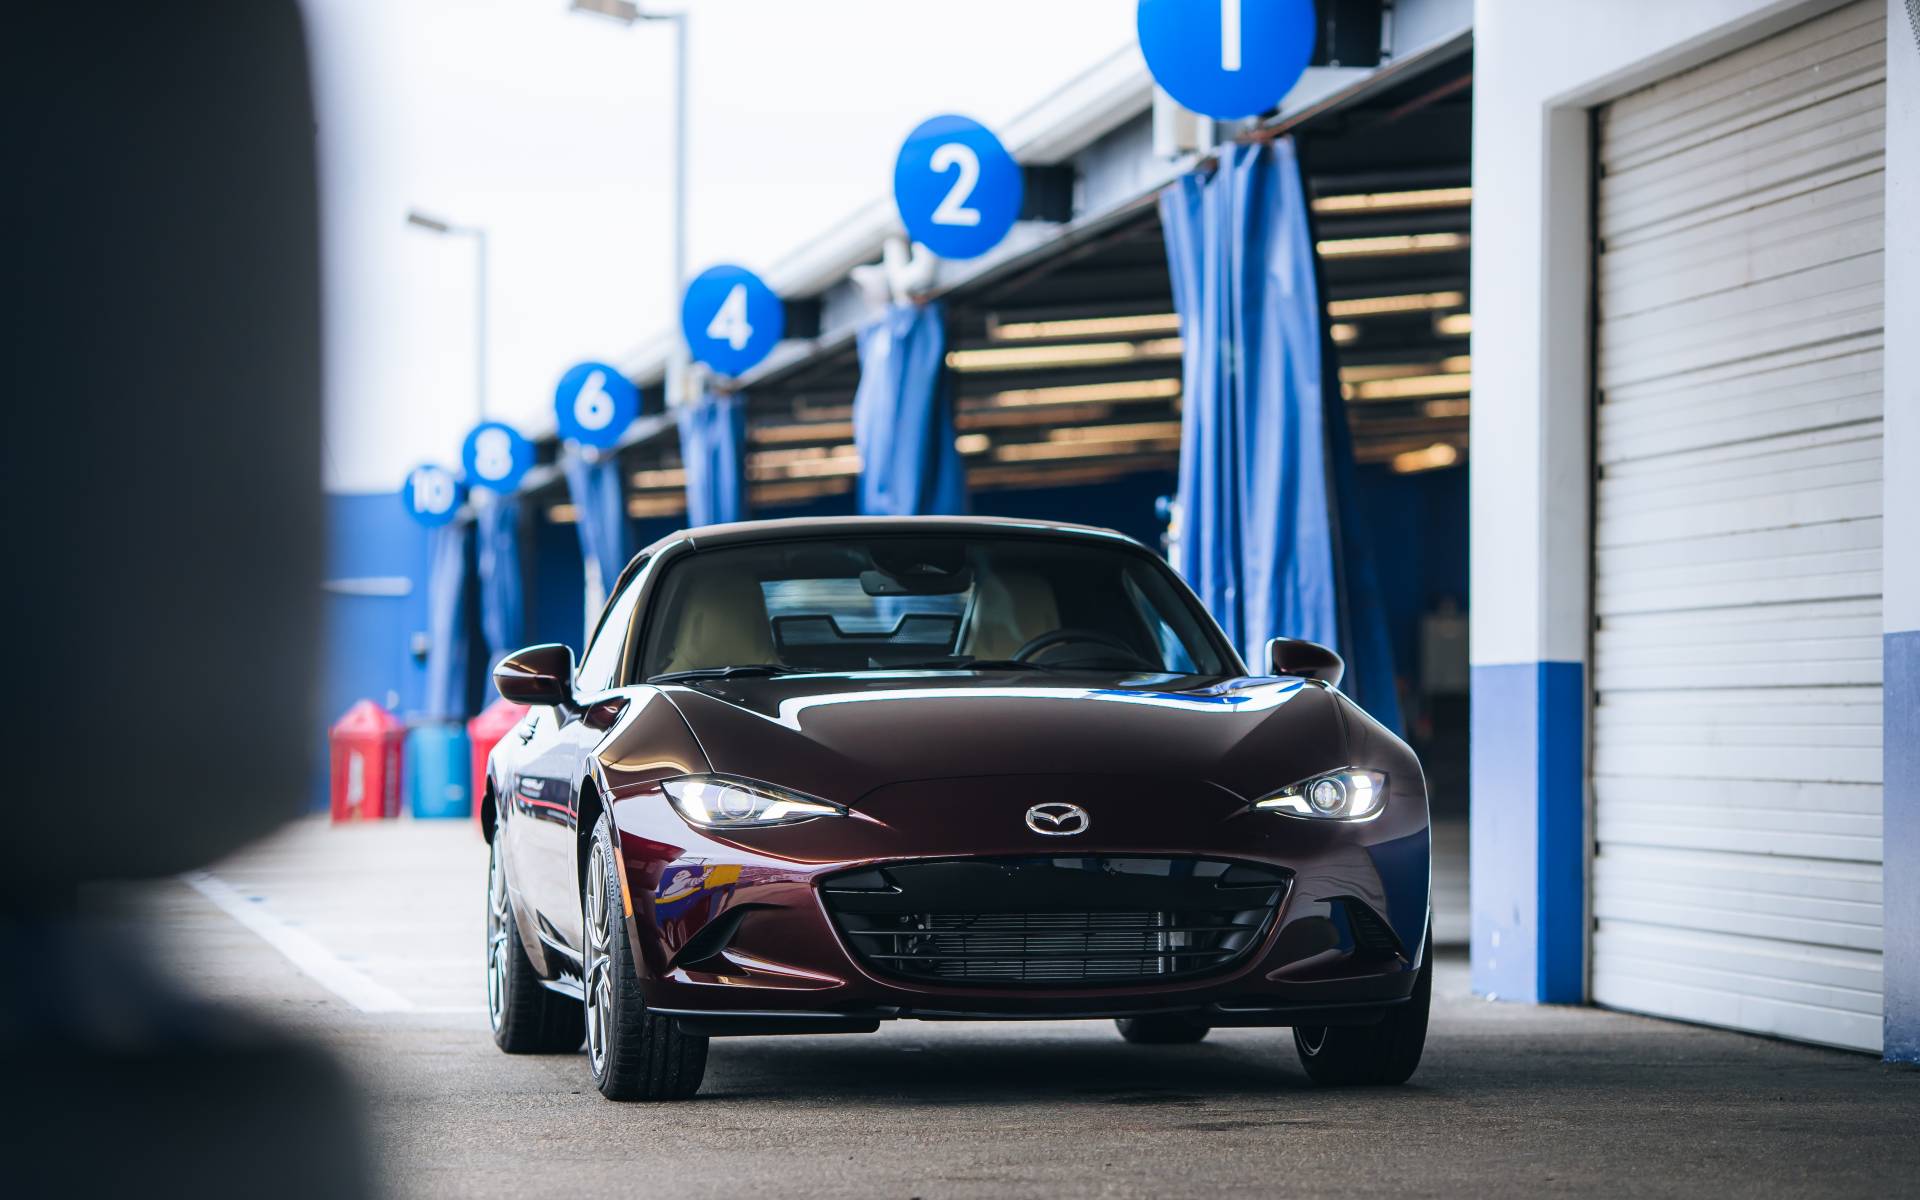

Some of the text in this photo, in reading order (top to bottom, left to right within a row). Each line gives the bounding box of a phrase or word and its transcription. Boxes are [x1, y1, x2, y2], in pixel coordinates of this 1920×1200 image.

[930, 143, 981, 226] 2
[707, 283, 753, 350] 4
[574, 370, 615, 431] 6
[475, 428, 513, 480] 8
[413, 470, 455, 514] 10
